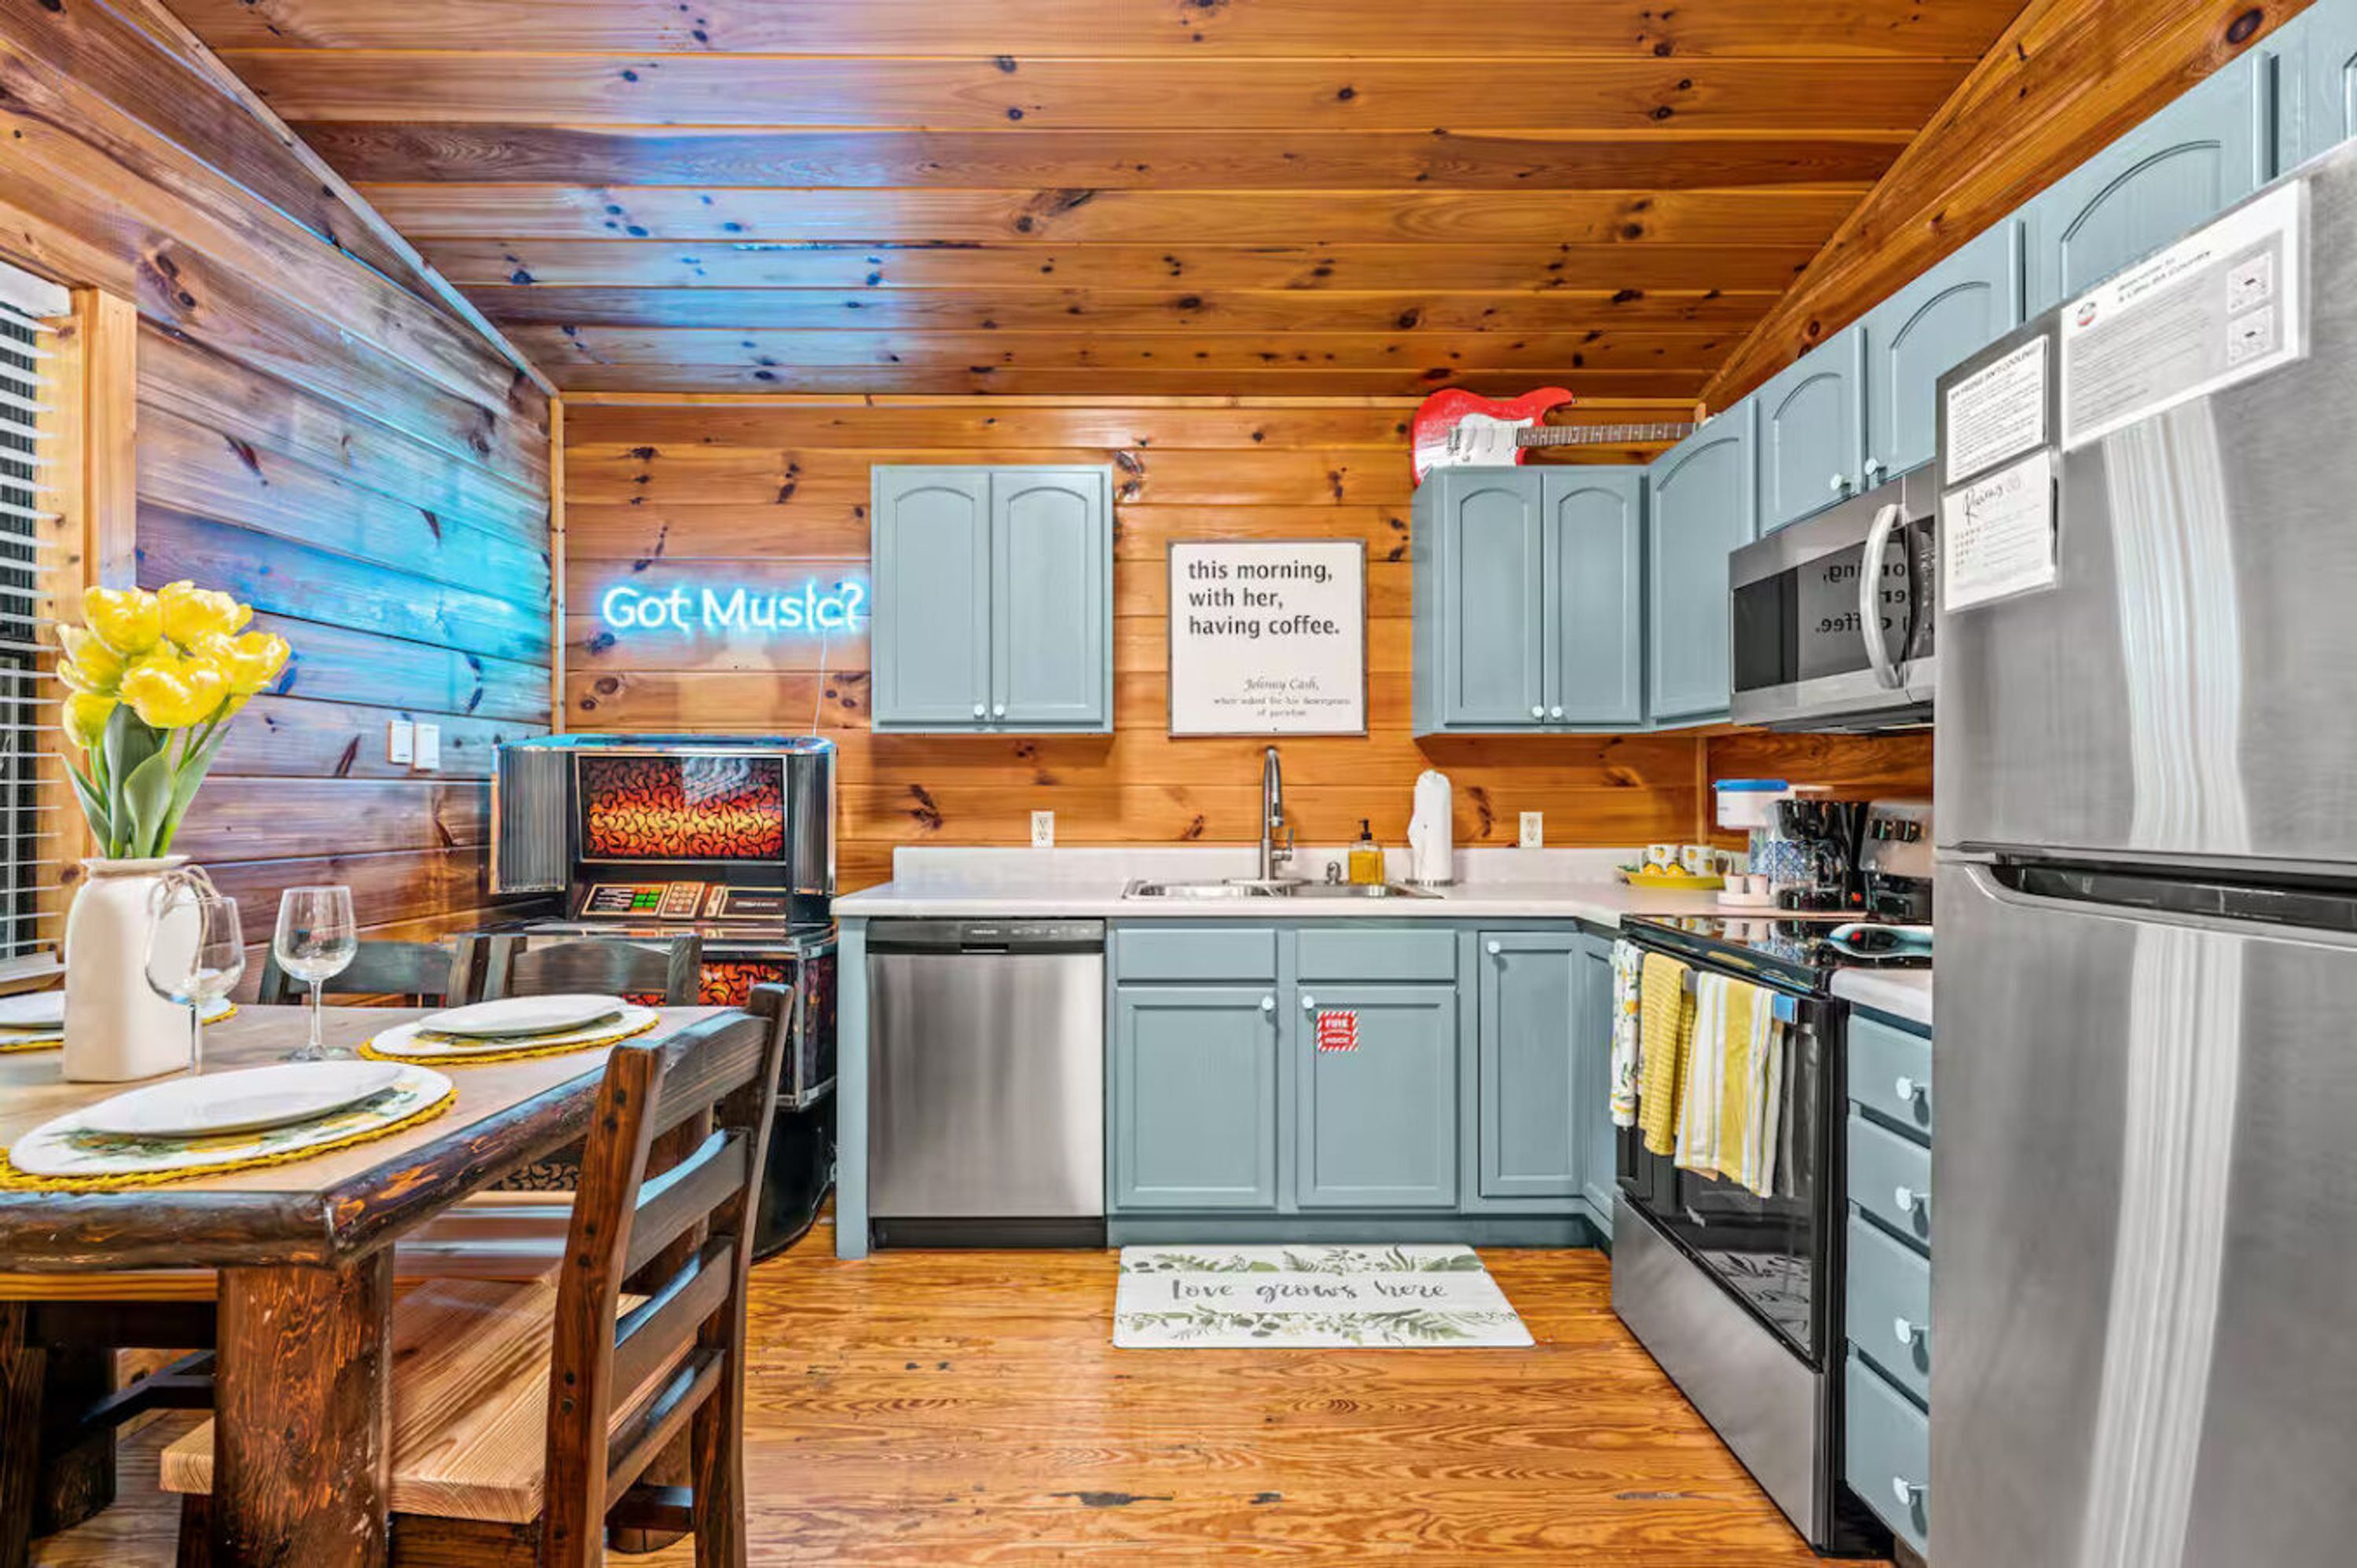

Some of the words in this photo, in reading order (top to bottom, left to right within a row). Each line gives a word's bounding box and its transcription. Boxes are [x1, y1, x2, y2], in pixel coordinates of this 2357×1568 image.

[1188, 559, 1228, 580] this
[1237, 559, 1333, 583] morning,
[602, 585, 691, 632] Got
[702, 579, 864, 632] Music?
[1189, 587, 1234, 606] with
[1243, 587, 1284, 610] her,
[1189, 615, 1260, 639] having
[1268, 614, 1341, 635] coffee.
[1256, 1282, 1358, 1304] grows
[1374, 1280, 1448, 1298] here
